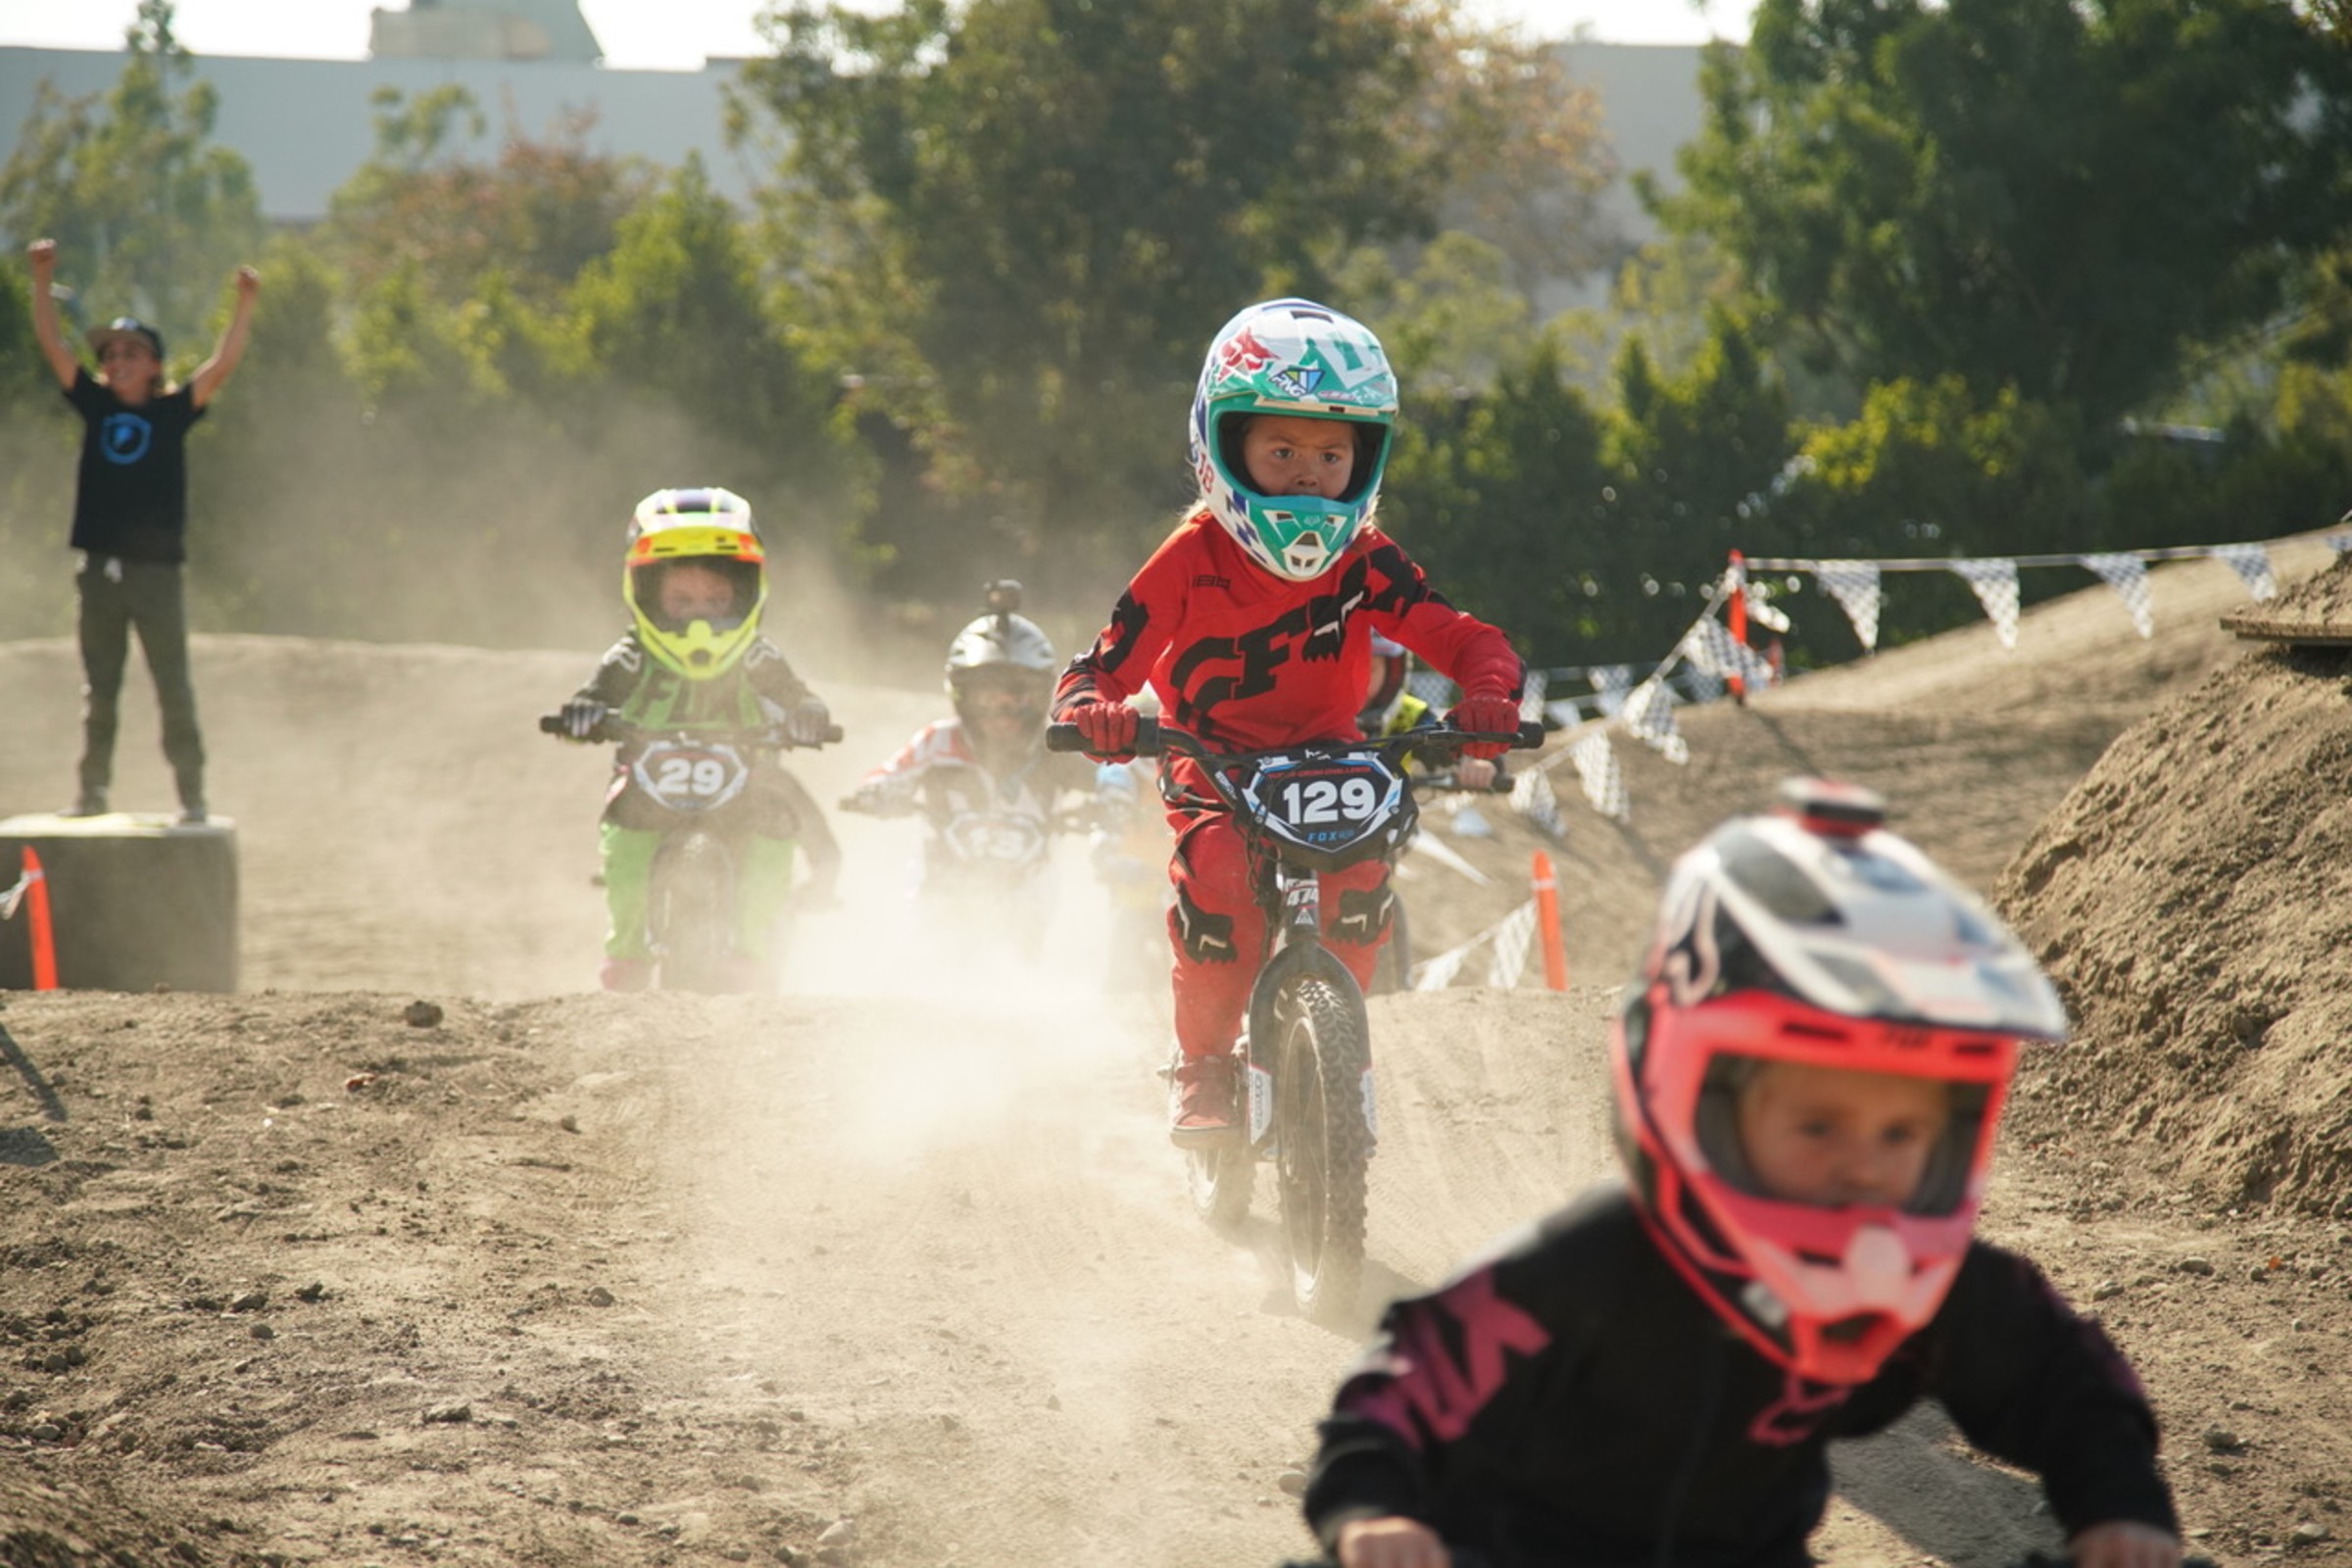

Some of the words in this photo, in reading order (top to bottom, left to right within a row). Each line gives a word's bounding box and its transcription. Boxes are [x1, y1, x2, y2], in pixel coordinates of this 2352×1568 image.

[657, 758, 724, 795] 29
[1283, 778, 1375, 824] 129
[1306, 831, 1338, 842] FOX
